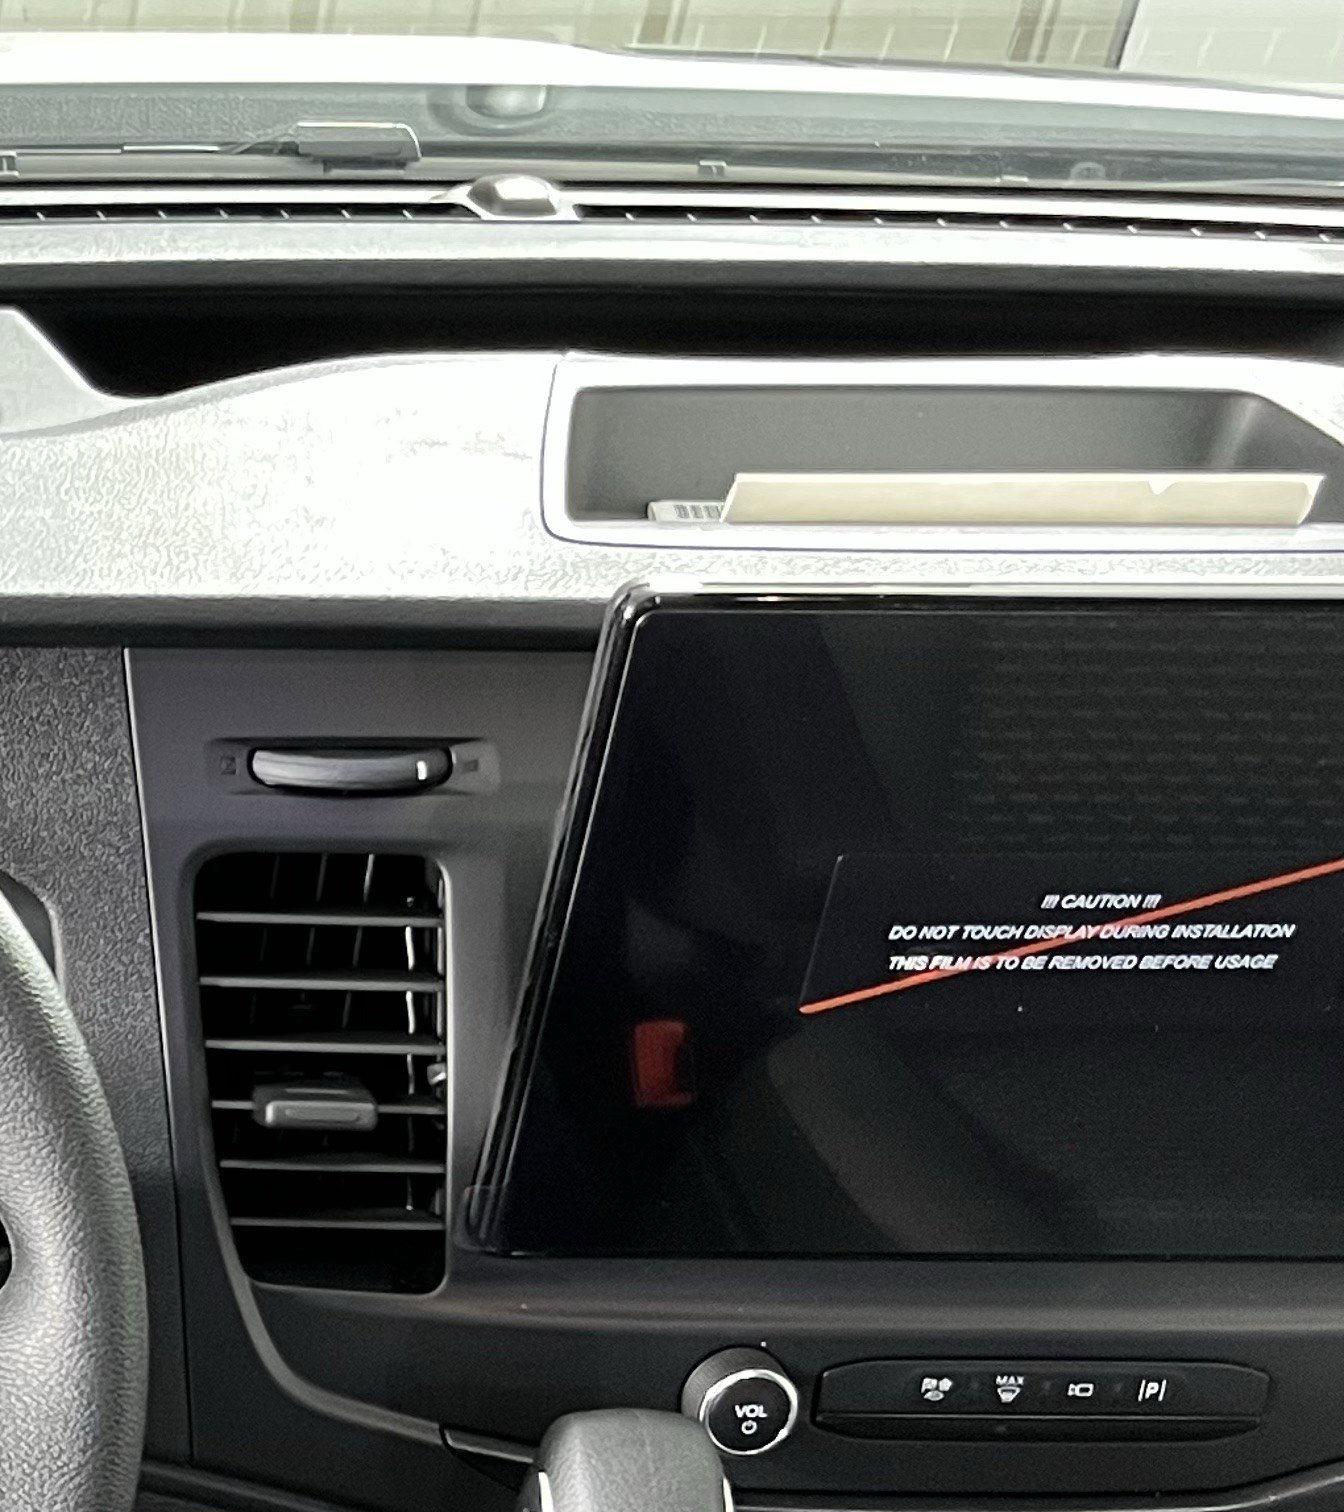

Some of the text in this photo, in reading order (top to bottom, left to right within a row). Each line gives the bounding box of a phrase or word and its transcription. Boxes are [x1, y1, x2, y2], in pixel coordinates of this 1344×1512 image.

[1061, 895, 1141, 909] CAUTION
[888, 923, 1296, 940] DO NOT TOUCH DISPLAY DURING INSTALLATION
[888, 954, 1278, 971] THIS FILM IS TO BE REMOVED BEFORE USAGE
[996, 1375, 1024, 1385] MAX
[734, 1405, 767, 1419] VOL
